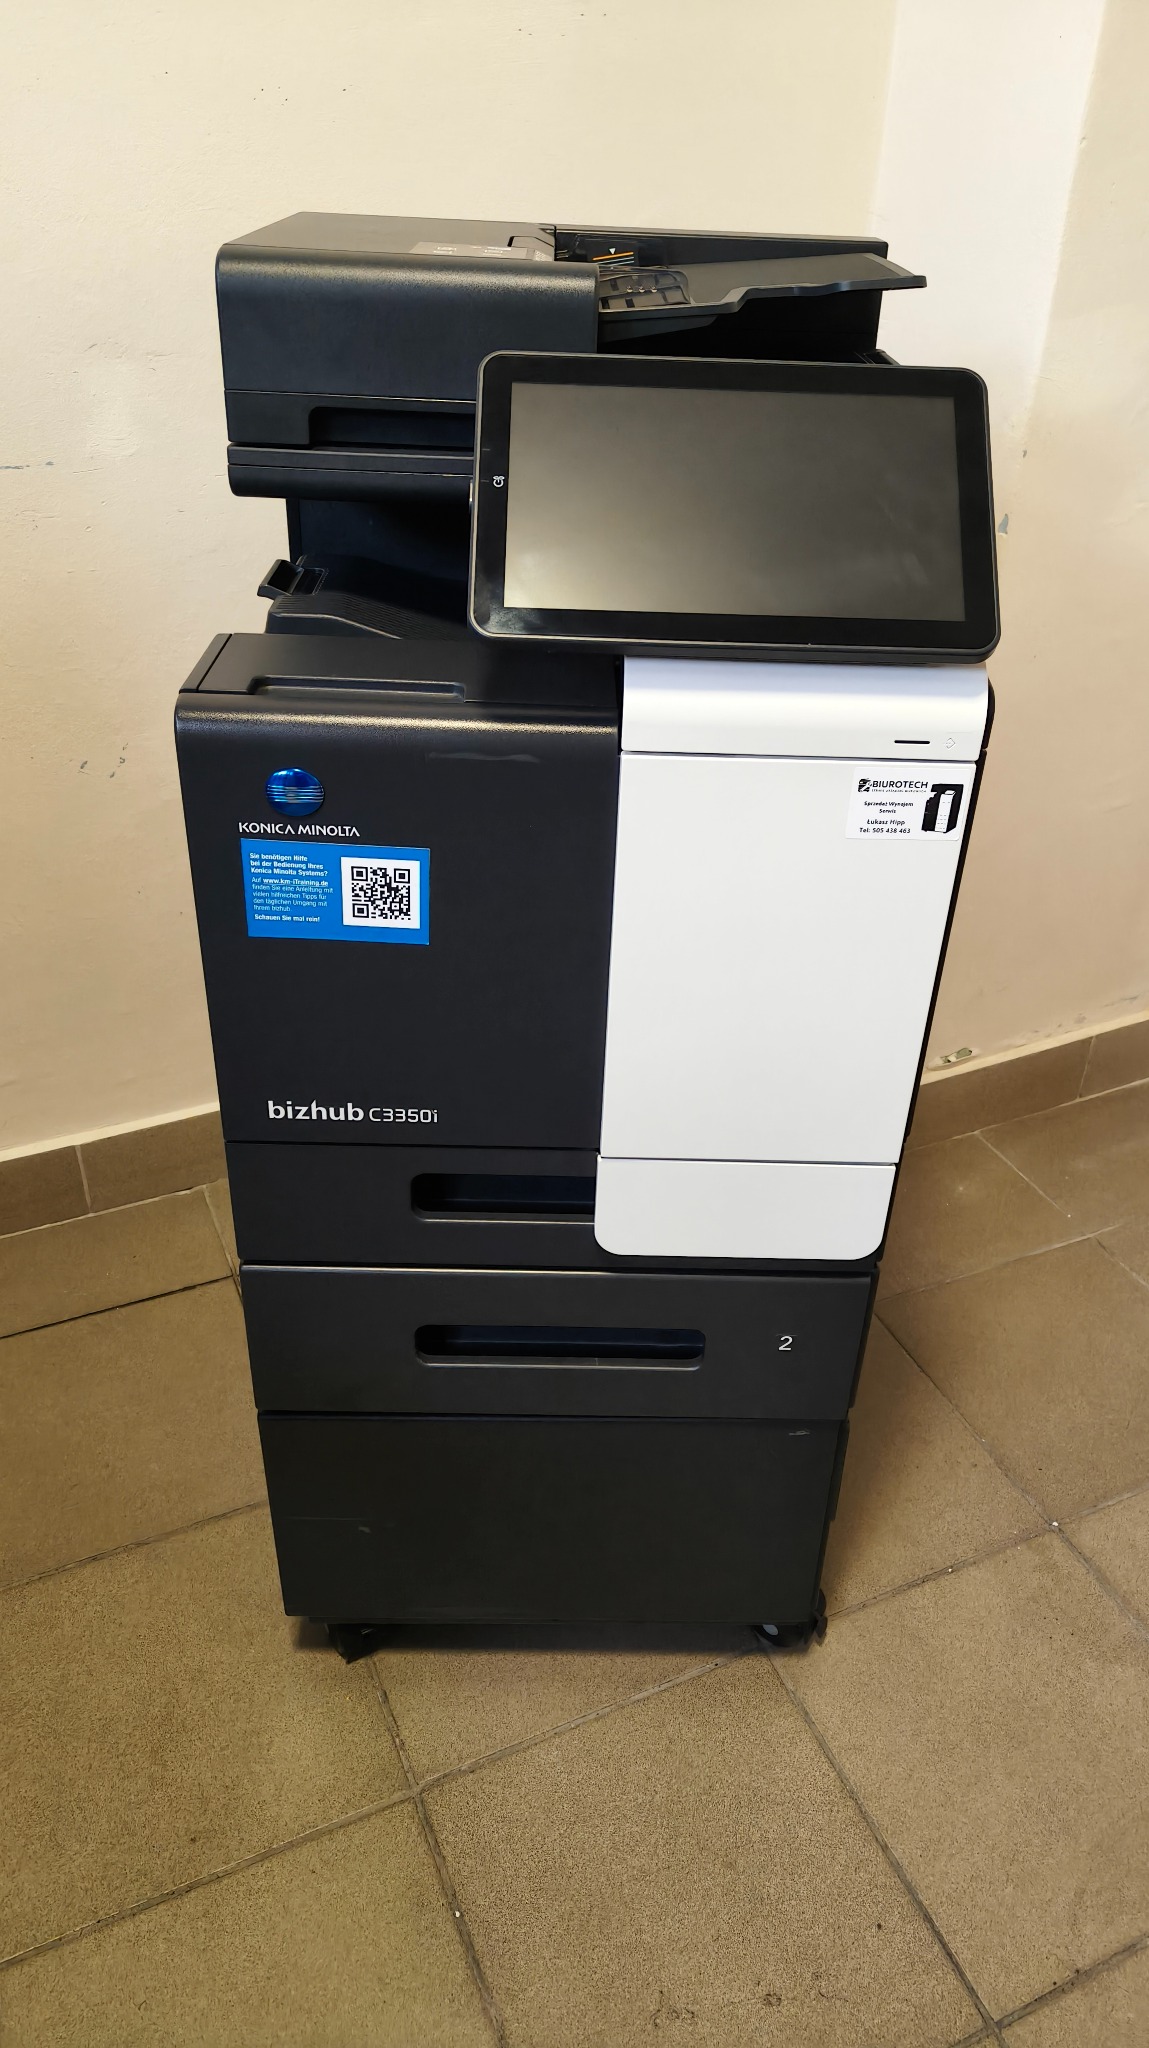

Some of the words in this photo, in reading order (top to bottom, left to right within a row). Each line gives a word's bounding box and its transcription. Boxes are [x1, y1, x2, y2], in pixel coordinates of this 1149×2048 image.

[873, 780, 928, 788] BIUROTECH
[238, 822, 295, 834] KONICA
[298, 824, 360, 837] MINOLTA
[274, 861, 306, 869] Bedienung
[263, 878, 328, 886] www.km-iTraining.de
[267, 1100, 364, 1121] bizhub
[369, 1107, 438, 1123] C3350i
[778, 1336, 792, 1350] 2
